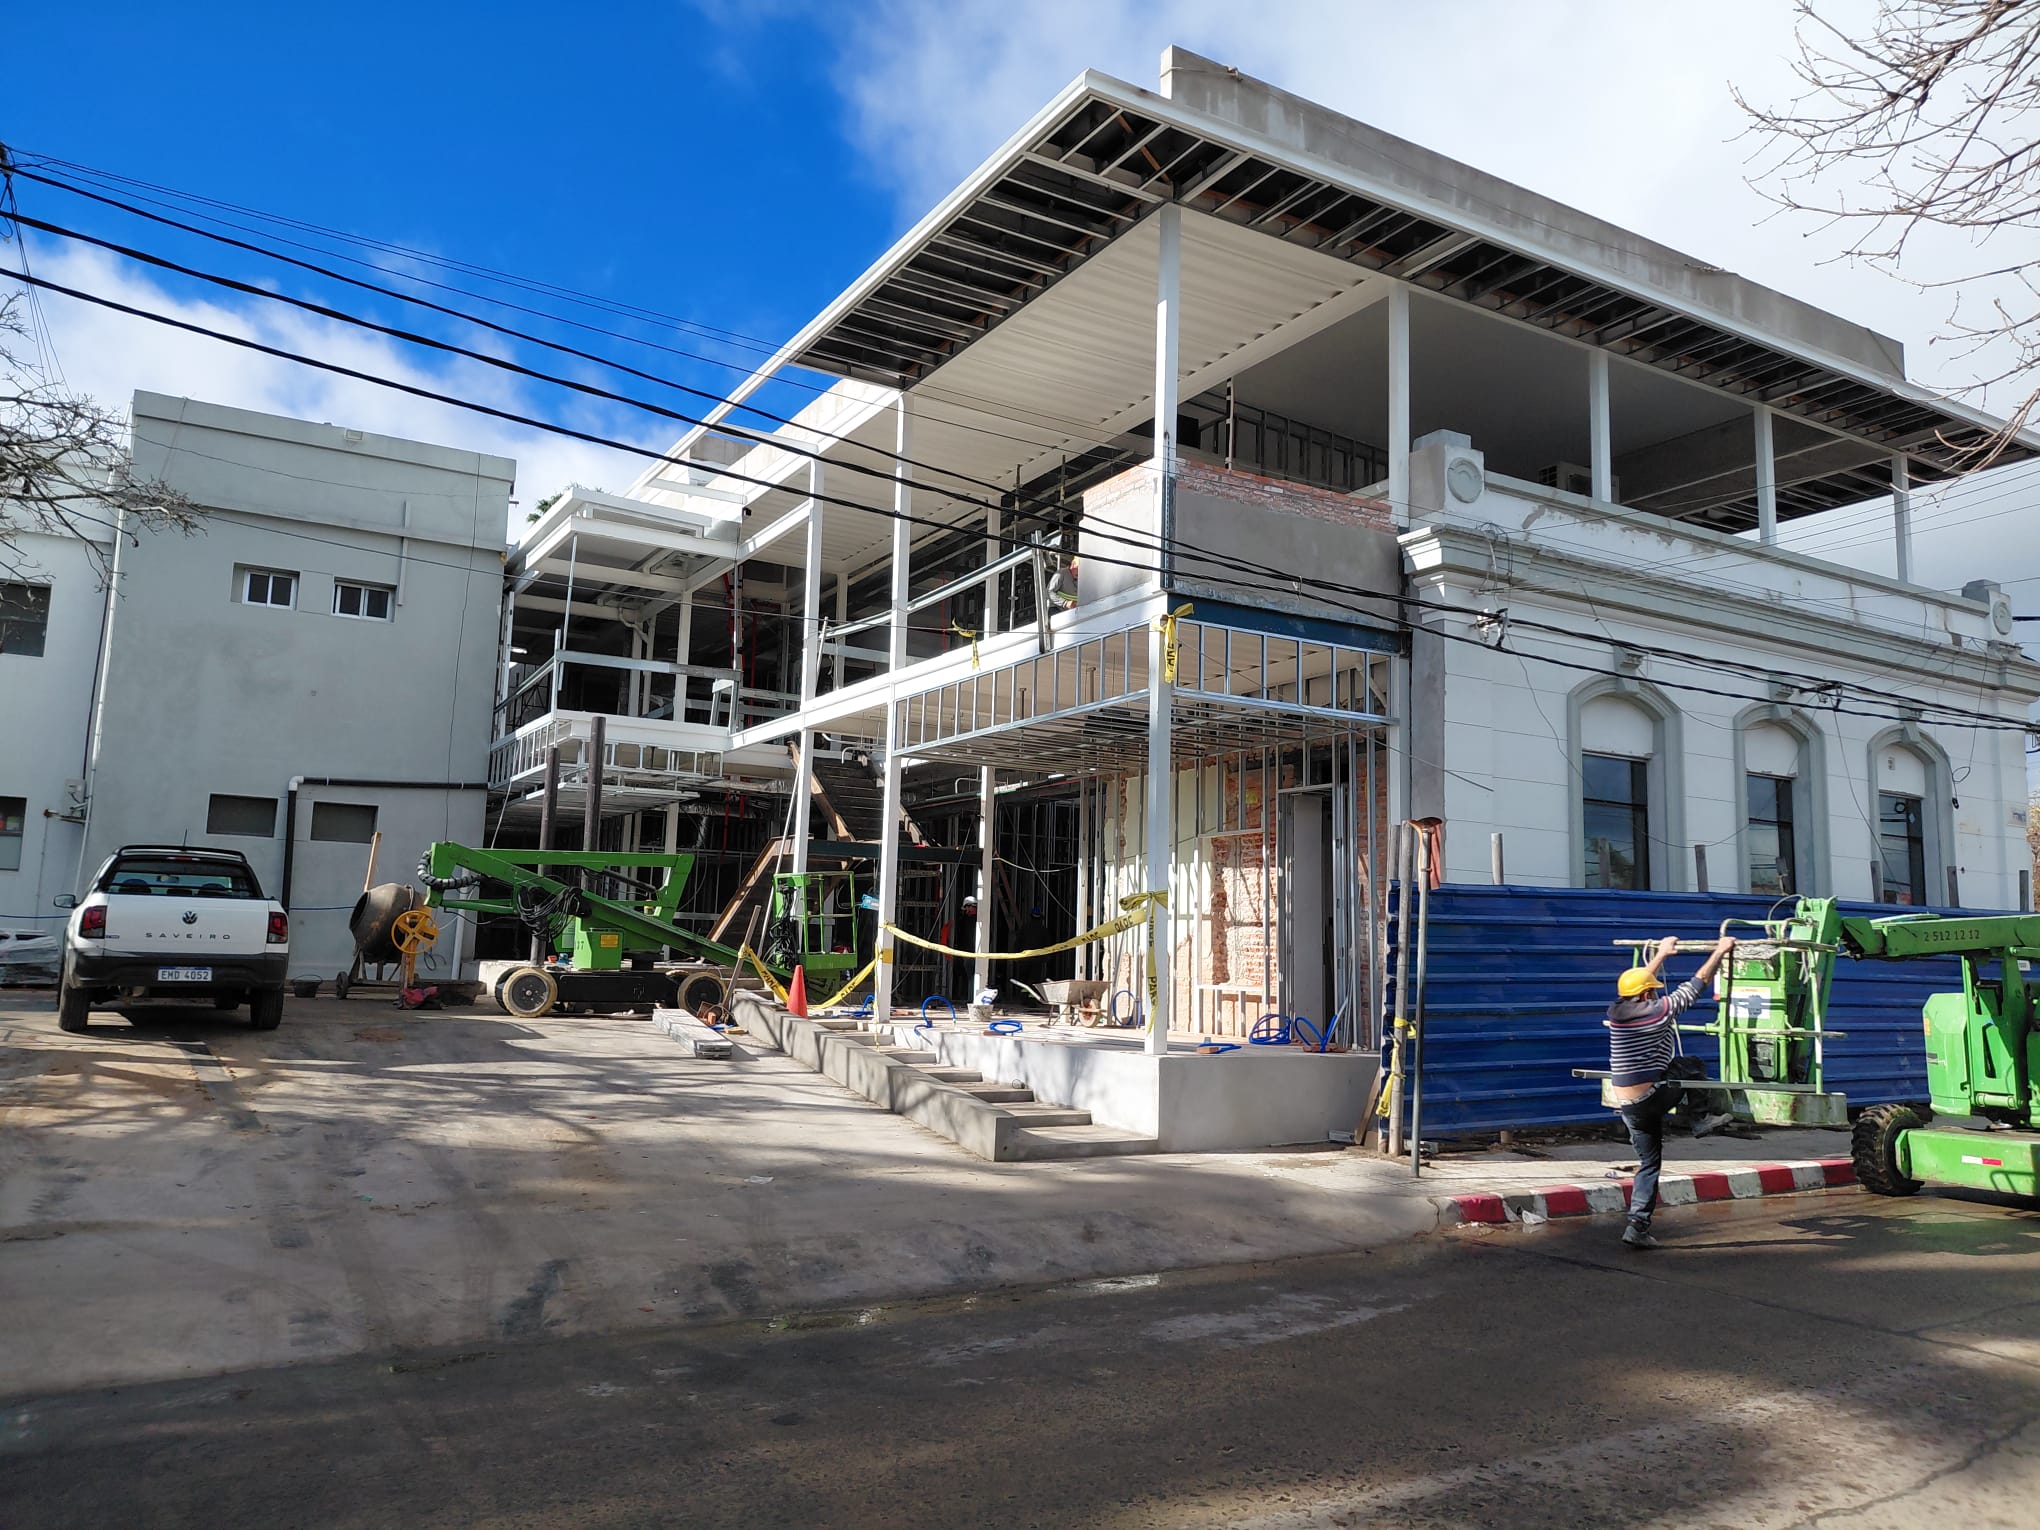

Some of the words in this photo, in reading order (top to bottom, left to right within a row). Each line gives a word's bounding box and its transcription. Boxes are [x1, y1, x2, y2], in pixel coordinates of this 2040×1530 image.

[145, 932, 231, 940] SAVEIRO
[161, 970, 180, 980] EMD
[184, 970, 209, 980] 4052
